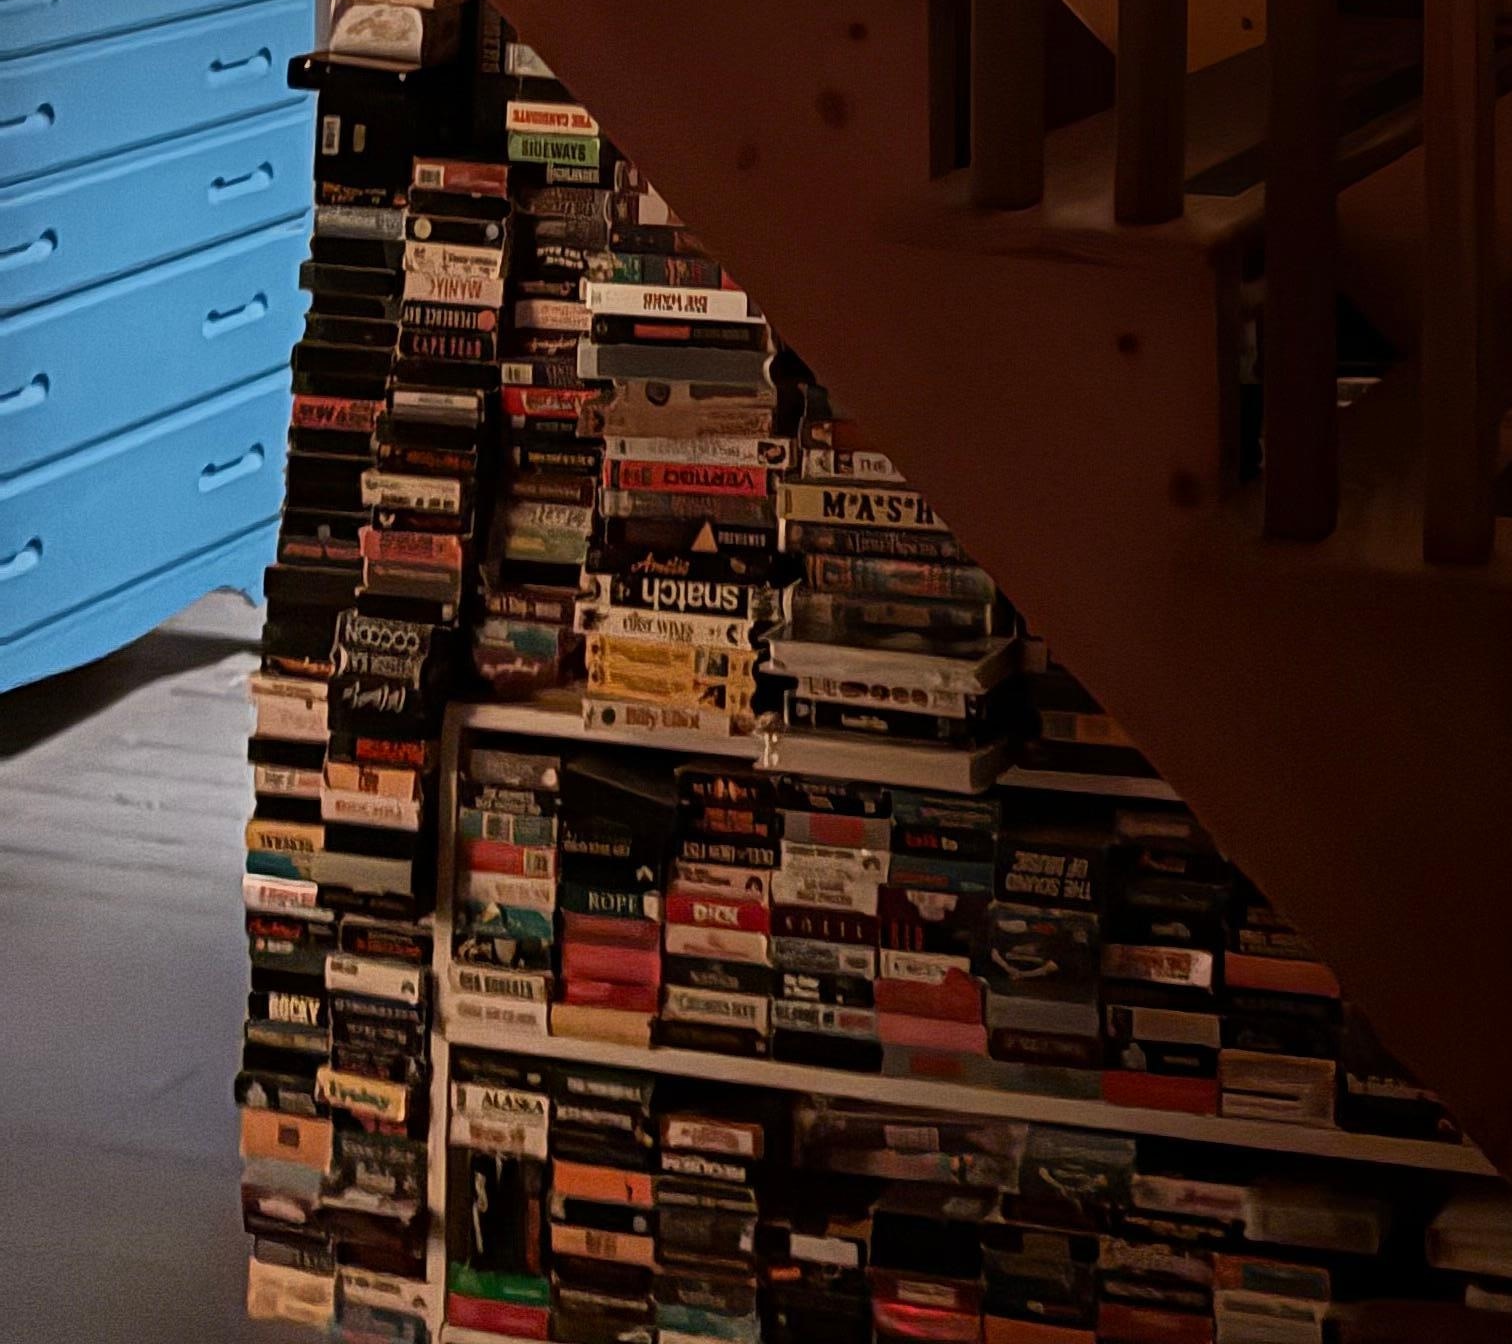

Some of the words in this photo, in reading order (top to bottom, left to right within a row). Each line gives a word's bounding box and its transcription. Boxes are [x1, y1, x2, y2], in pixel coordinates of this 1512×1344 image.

[521, 139, 586, 162] SIDEWAYS
[663, 470, 754, 489] VERTIGO
[641, 577, 741, 612] snatch
[346, 617, 421, 650] COCOON
[482, 1091, 544, 1114] ALASKA
